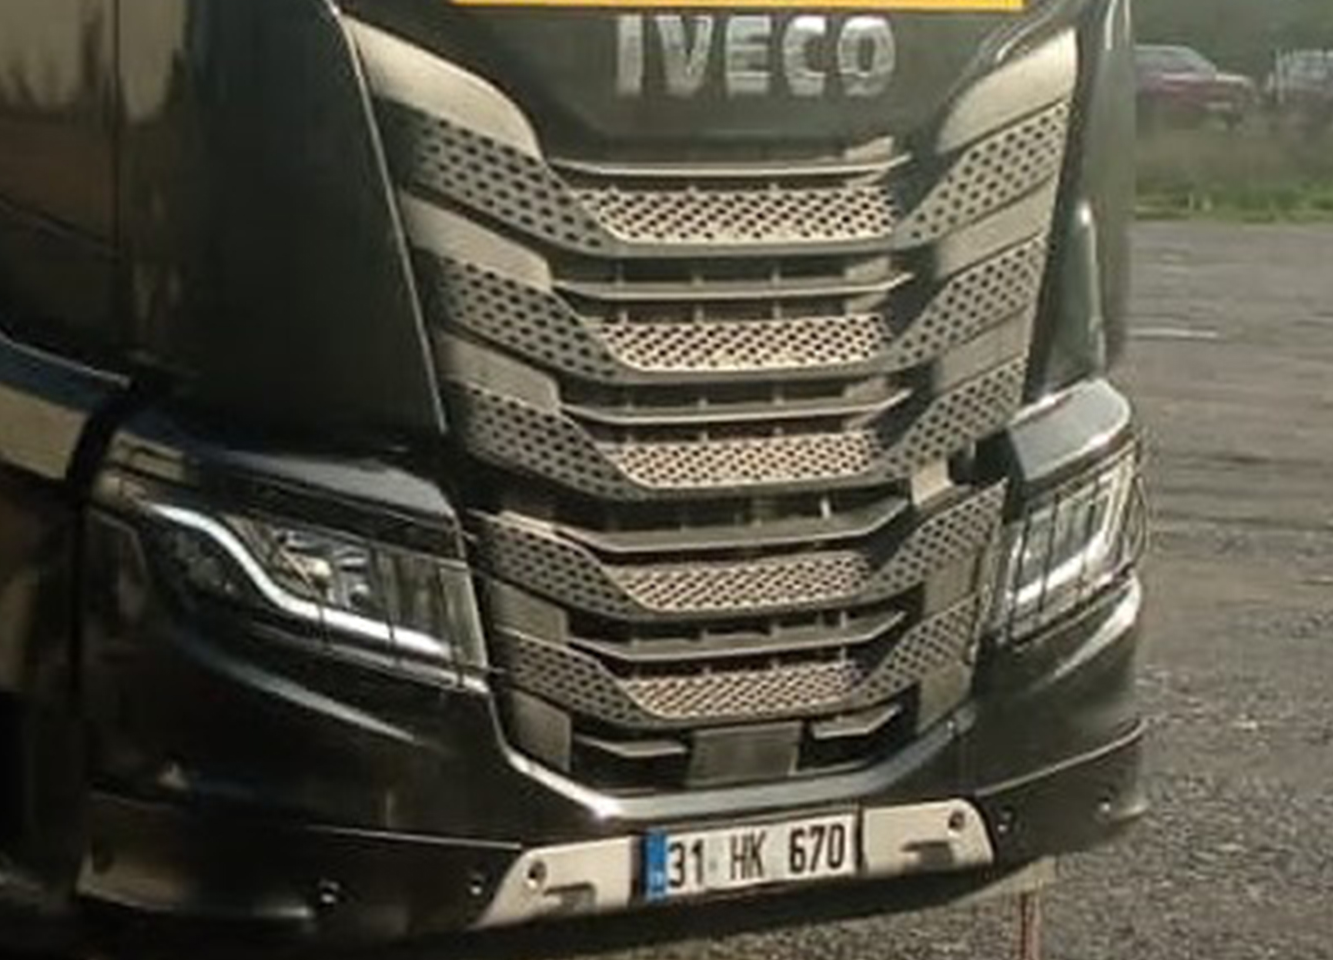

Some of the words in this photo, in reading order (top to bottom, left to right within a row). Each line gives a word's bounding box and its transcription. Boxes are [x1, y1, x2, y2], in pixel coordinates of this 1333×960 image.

[615, 14, 897, 98] IVECO
[667, 839, 705, 889] 31
[729, 829, 767, 881] HK
[788, 823, 846, 875] 670
